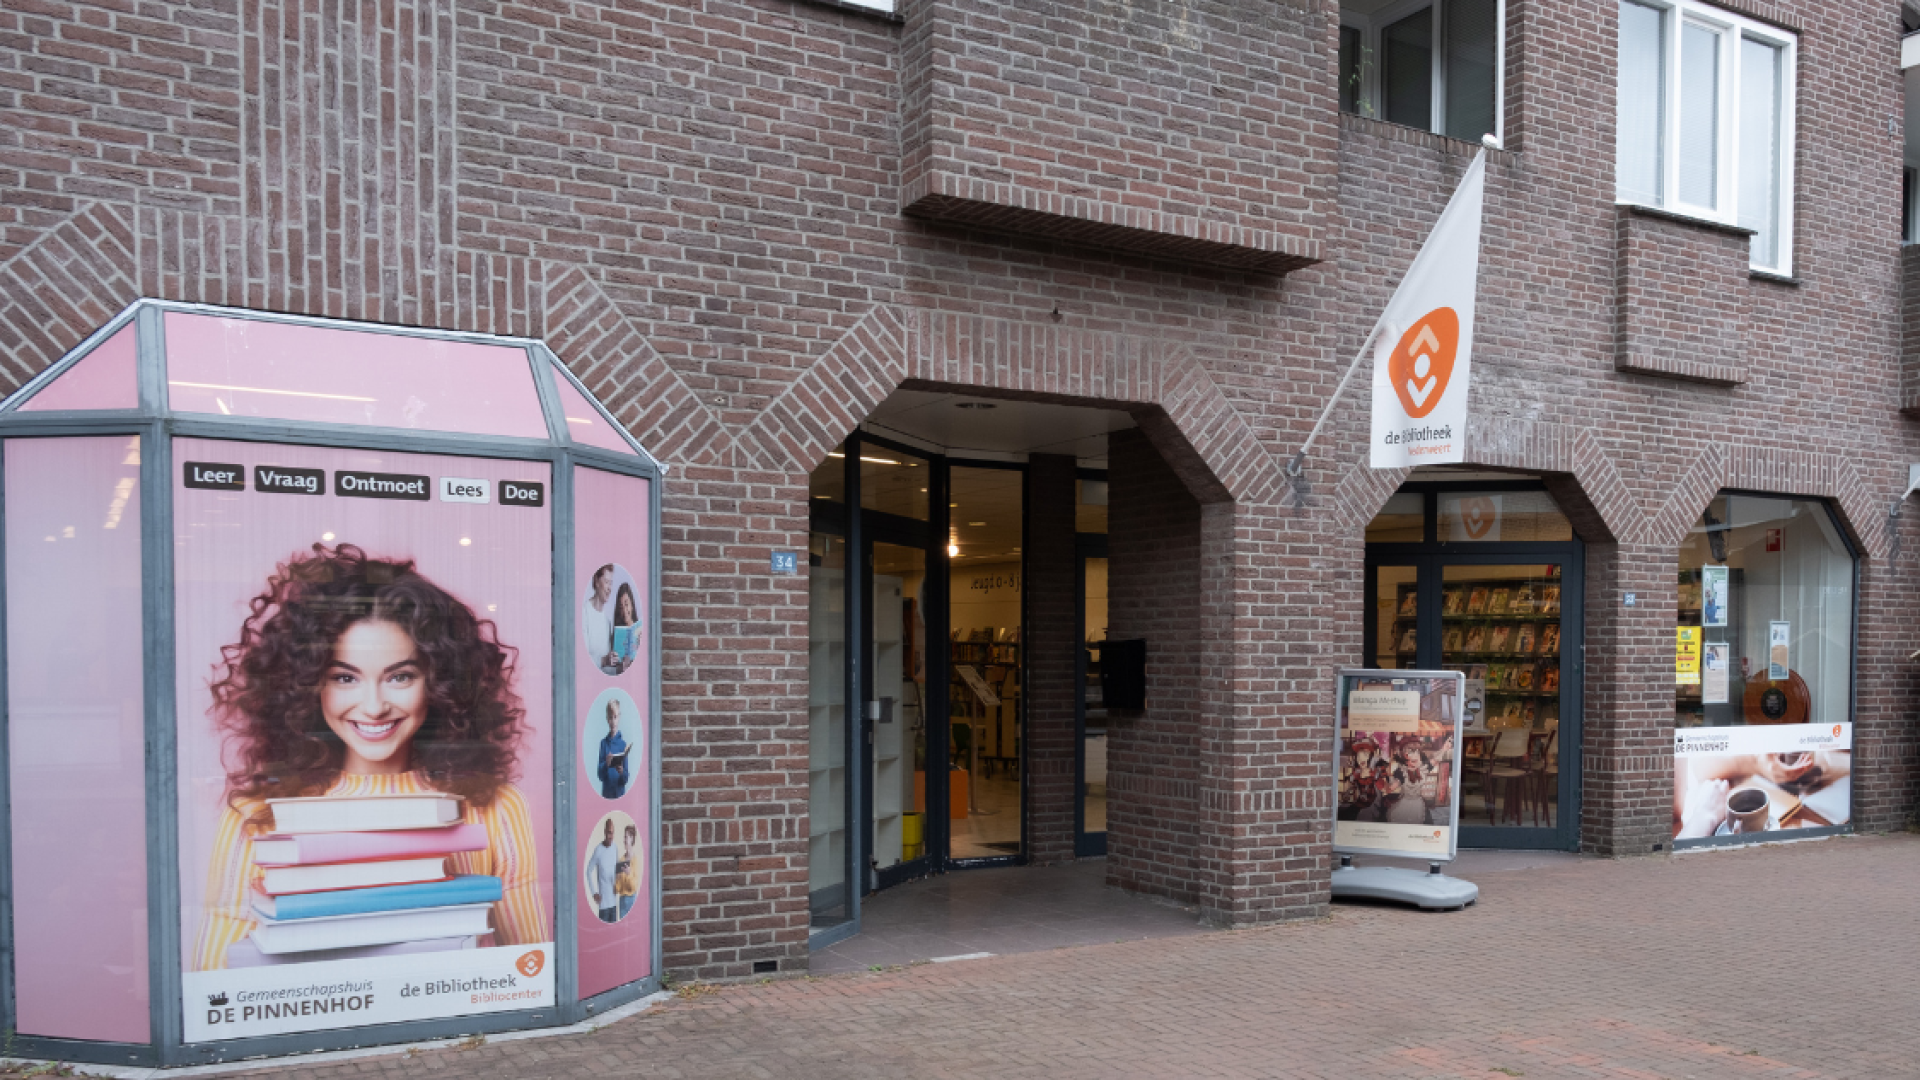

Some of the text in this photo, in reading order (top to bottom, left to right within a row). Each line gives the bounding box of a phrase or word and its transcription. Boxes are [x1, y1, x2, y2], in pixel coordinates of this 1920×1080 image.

[1384, 431, 1400, 444] de
[193, 466, 236, 484] Leer
[259, 469, 318, 493] Vraag
[340, 475, 426, 495] Ontmoet
[447, 482, 483, 498] Lees
[504, 485, 539, 501] Doe
[775, 555, 793, 567] 34
[1676, 743, 1685, 752] DE
[236, 979, 374, 1003] Gemeenschapshuis
[400, 973, 517, 998] de Bibliotheek
[470, 989, 543, 1004] Bibliocenter
[207, 994, 375, 1025] DE PINNENHOF
